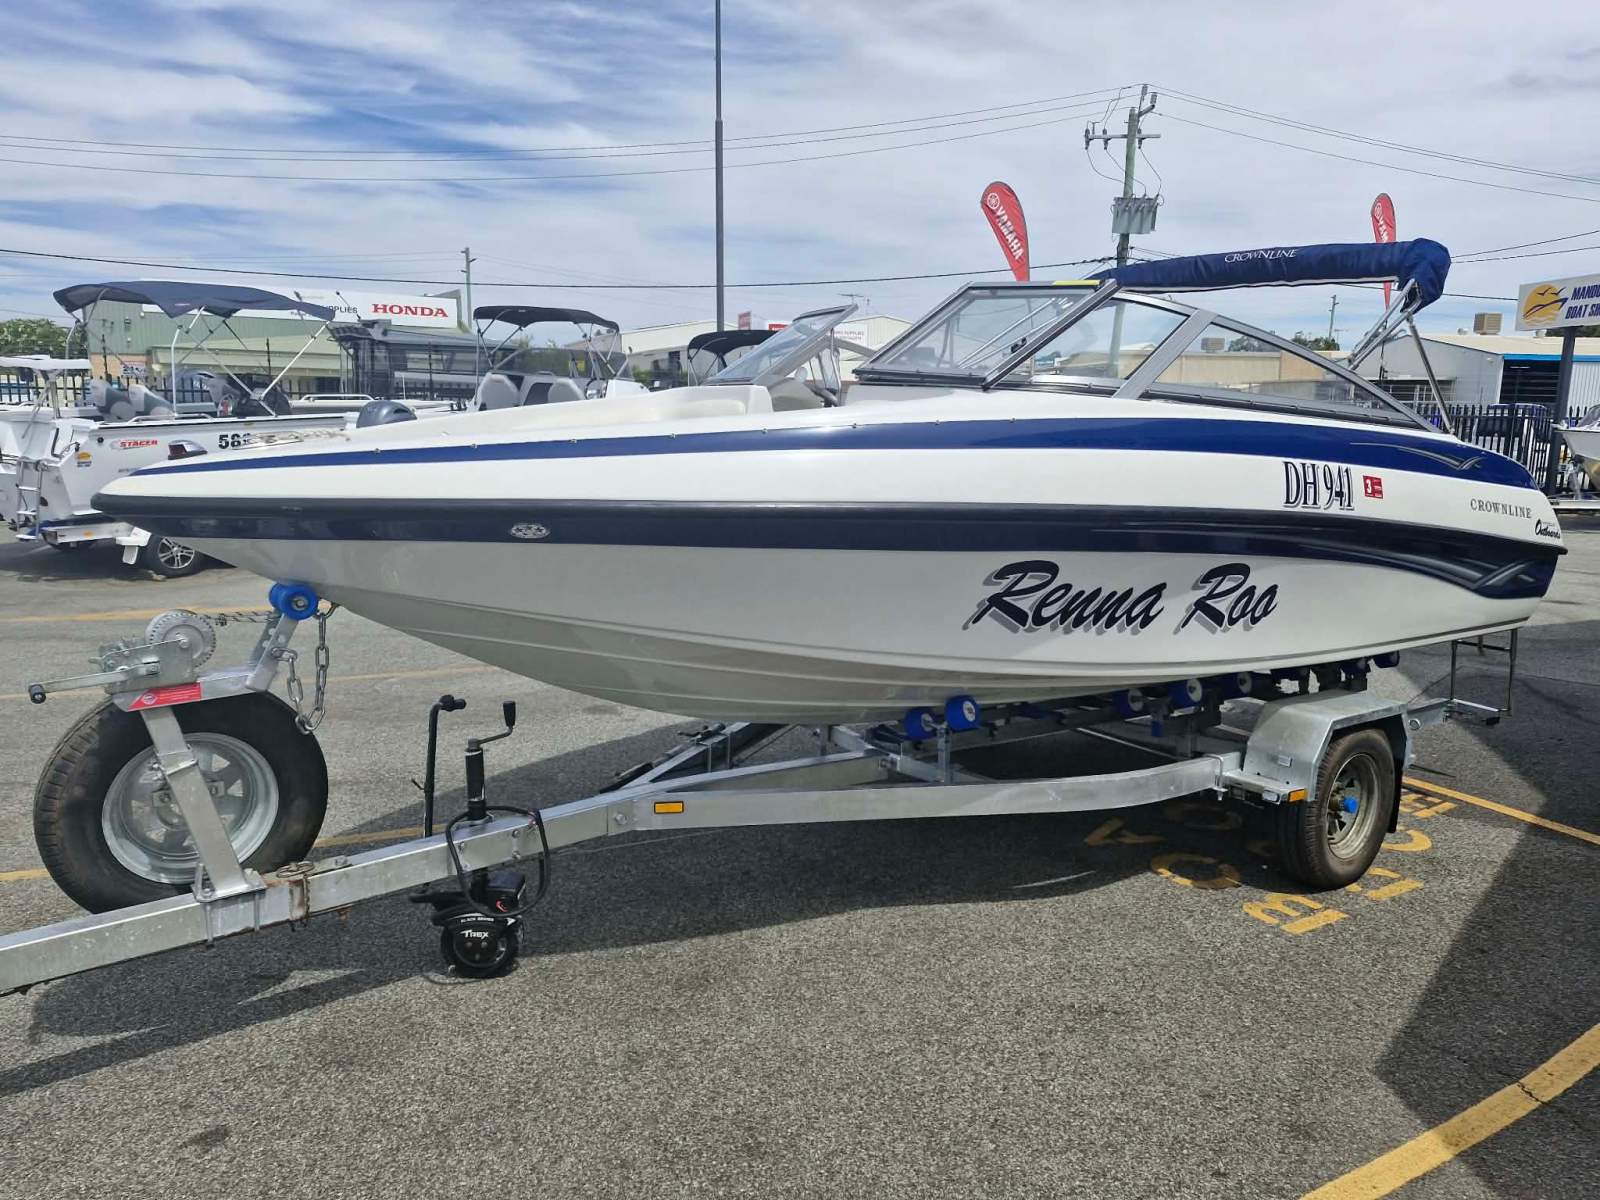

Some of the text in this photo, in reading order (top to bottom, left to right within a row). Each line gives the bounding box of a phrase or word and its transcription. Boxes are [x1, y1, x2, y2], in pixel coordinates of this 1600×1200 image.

[995, 205, 1025, 260] YAMAHA
[1224, 249, 1297, 263] CROWNLINE
[371, 303, 449, 318] HONDA
[1565, 305, 1588, 320] BOAT
[1283, 461, 1355, 511] DH 941
[1470, 498, 1532, 519] CROWNLINE
[962, 559, 1280, 636] Renna Roo
